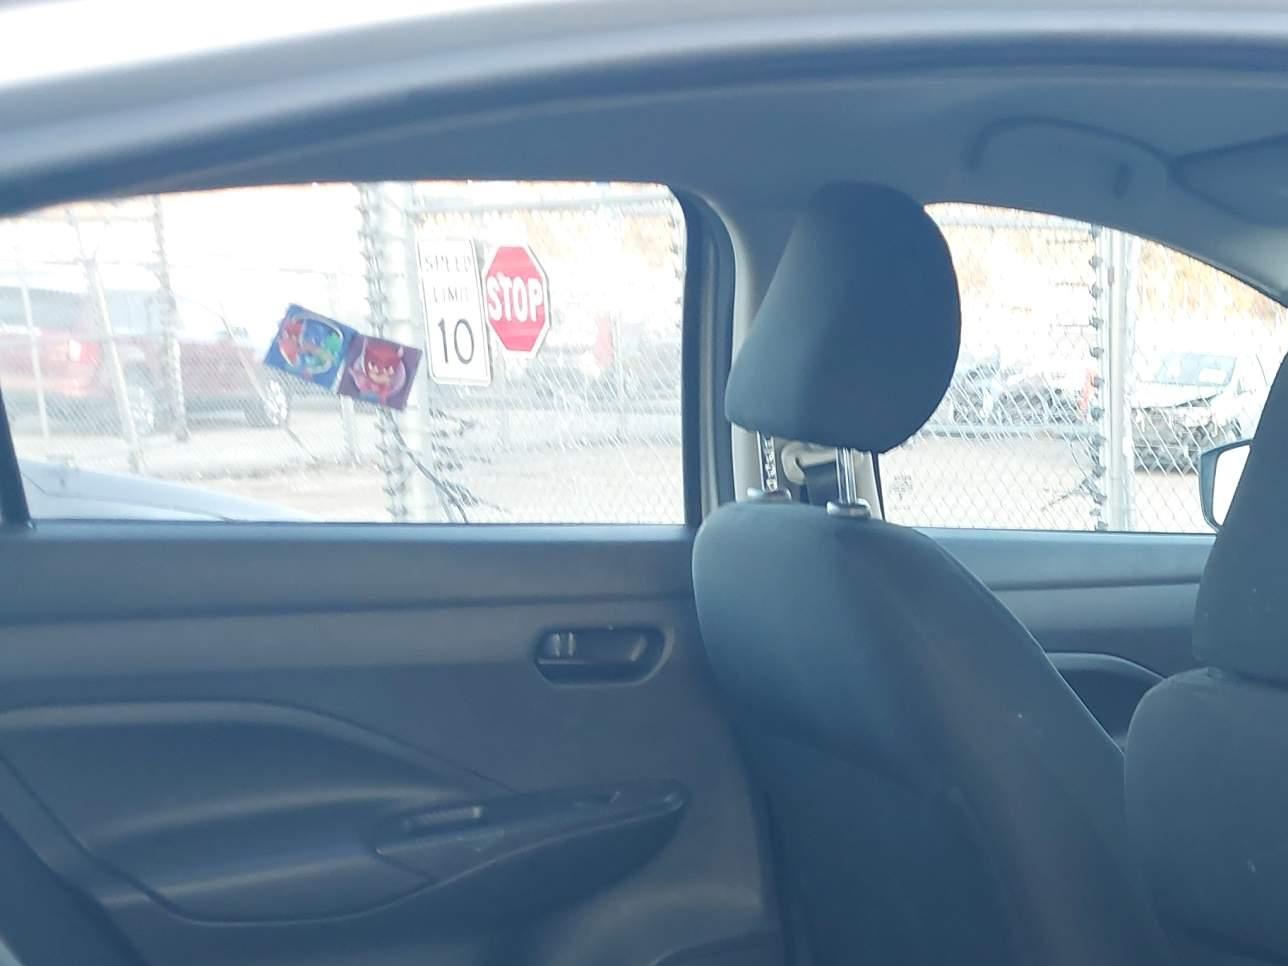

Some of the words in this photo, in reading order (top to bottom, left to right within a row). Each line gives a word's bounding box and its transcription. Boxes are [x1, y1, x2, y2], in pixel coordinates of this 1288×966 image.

[424, 255, 472, 272] SPEED
[486, 273, 543, 321] STOP
[438, 318, 474, 364] 10
